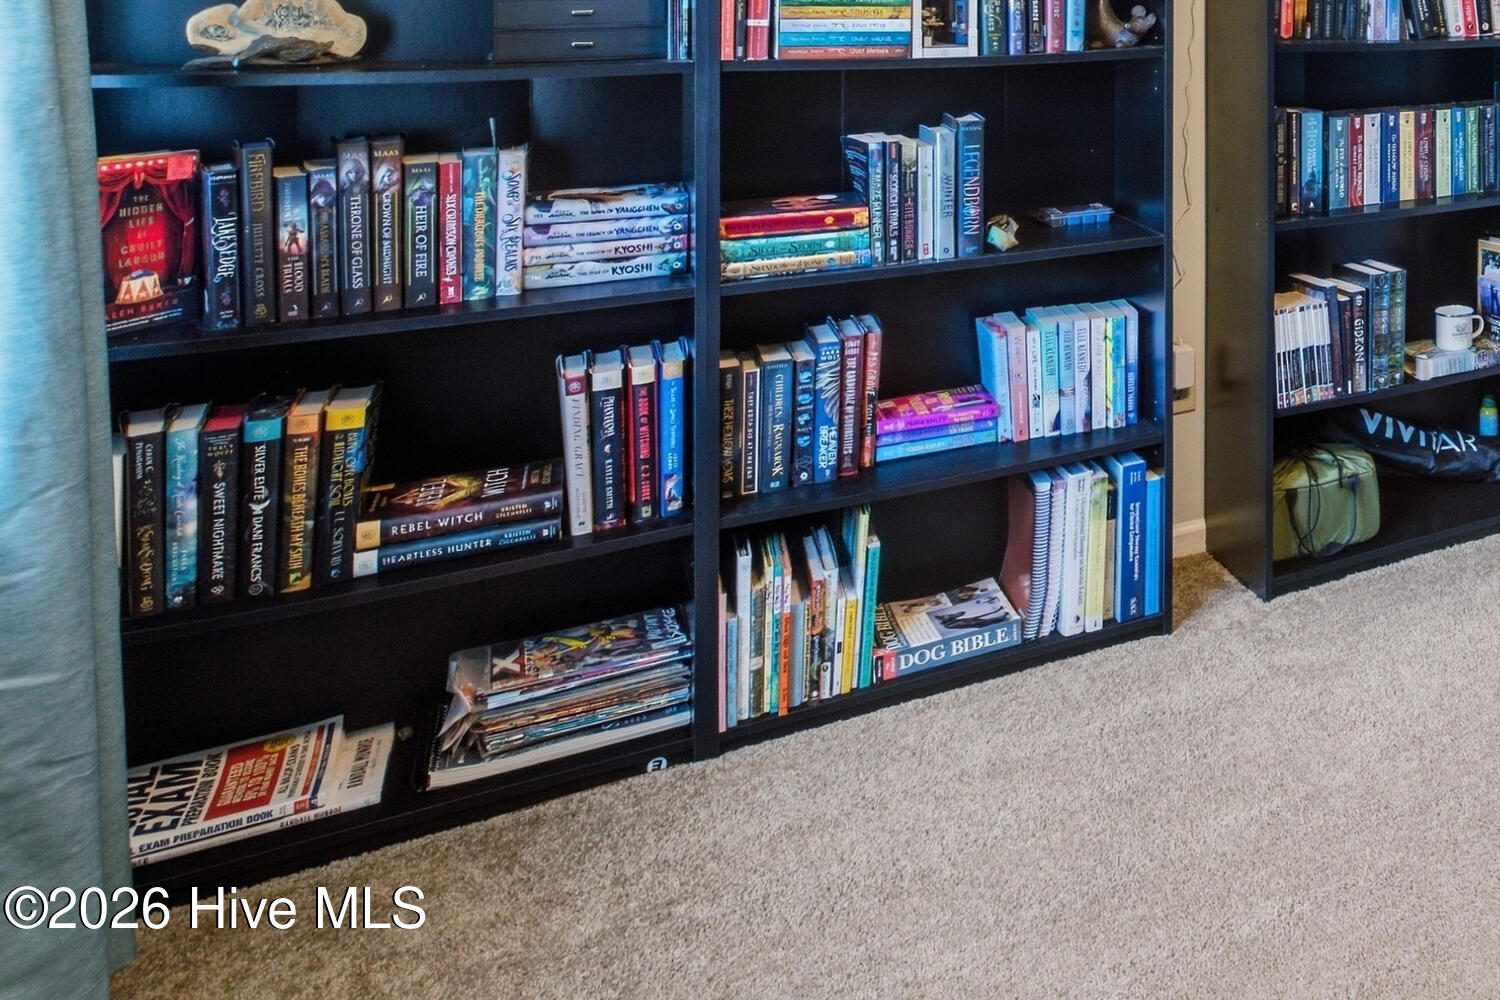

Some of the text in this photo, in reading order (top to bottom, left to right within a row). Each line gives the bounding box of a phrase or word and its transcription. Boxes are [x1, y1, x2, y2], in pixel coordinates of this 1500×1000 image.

[249, 154, 267, 211] FIREBIRD
[942, 174, 953, 218] WINTER
[963, 144, 981, 235] LEGENDBORN
[382, 192, 393, 226] CROWN
[613, 225, 660, 236] YANGCHEN
[615, 204, 660, 214] YANGCHEN
[872, 202, 882, 239] RUNNER
[889, 209, 898, 237] TRIALS
[211, 212, 237, 283] LAKESEDGE
[350, 195, 364, 289] THRONE OF GLASS
[382, 241, 393, 284] MIDNIGHT
[415, 206, 428, 278] HEIR OF FIRE
[500, 236, 522, 271] REALMS
[614, 243, 653, 254] KYOSHI
[254, 267, 264, 297] CROSS
[282, 263, 293, 294] TRIALS
[294, 261, 304, 293] BLOOD
[611, 263, 653, 276] KYOSHI
[1354, 319, 1364, 362] GIDEON
[865, 369, 877, 396] GROVE
[571, 399, 582, 442] FINDING
[772, 374, 784, 476] CHILDREN RAGNAROK
[1359, 408, 1478, 453] VIVITAR
[573, 447, 584, 479] GRACE
[818, 425, 829, 468] BREAKER
[829, 426, 838, 465] HEAVEN
[250, 445, 266, 582] SILVER ELITE DANI FRANCIS
[288, 446, 308, 569] THE BONES BENEATH MY SKIN
[391, 512, 484, 536] REBEL WITCH
[211, 482, 226, 580] SWEET NIGHTMARE
[382, 538, 493, 604] HEARTLESS HUNTER
[899, 628, 1010, 670] DOG BIBLE
[133, 761, 203, 837] EXAM
[181, 780, 216, 827] PREPARATION
[138, 808, 275, 853] EXAM PREPARATION BOOK
